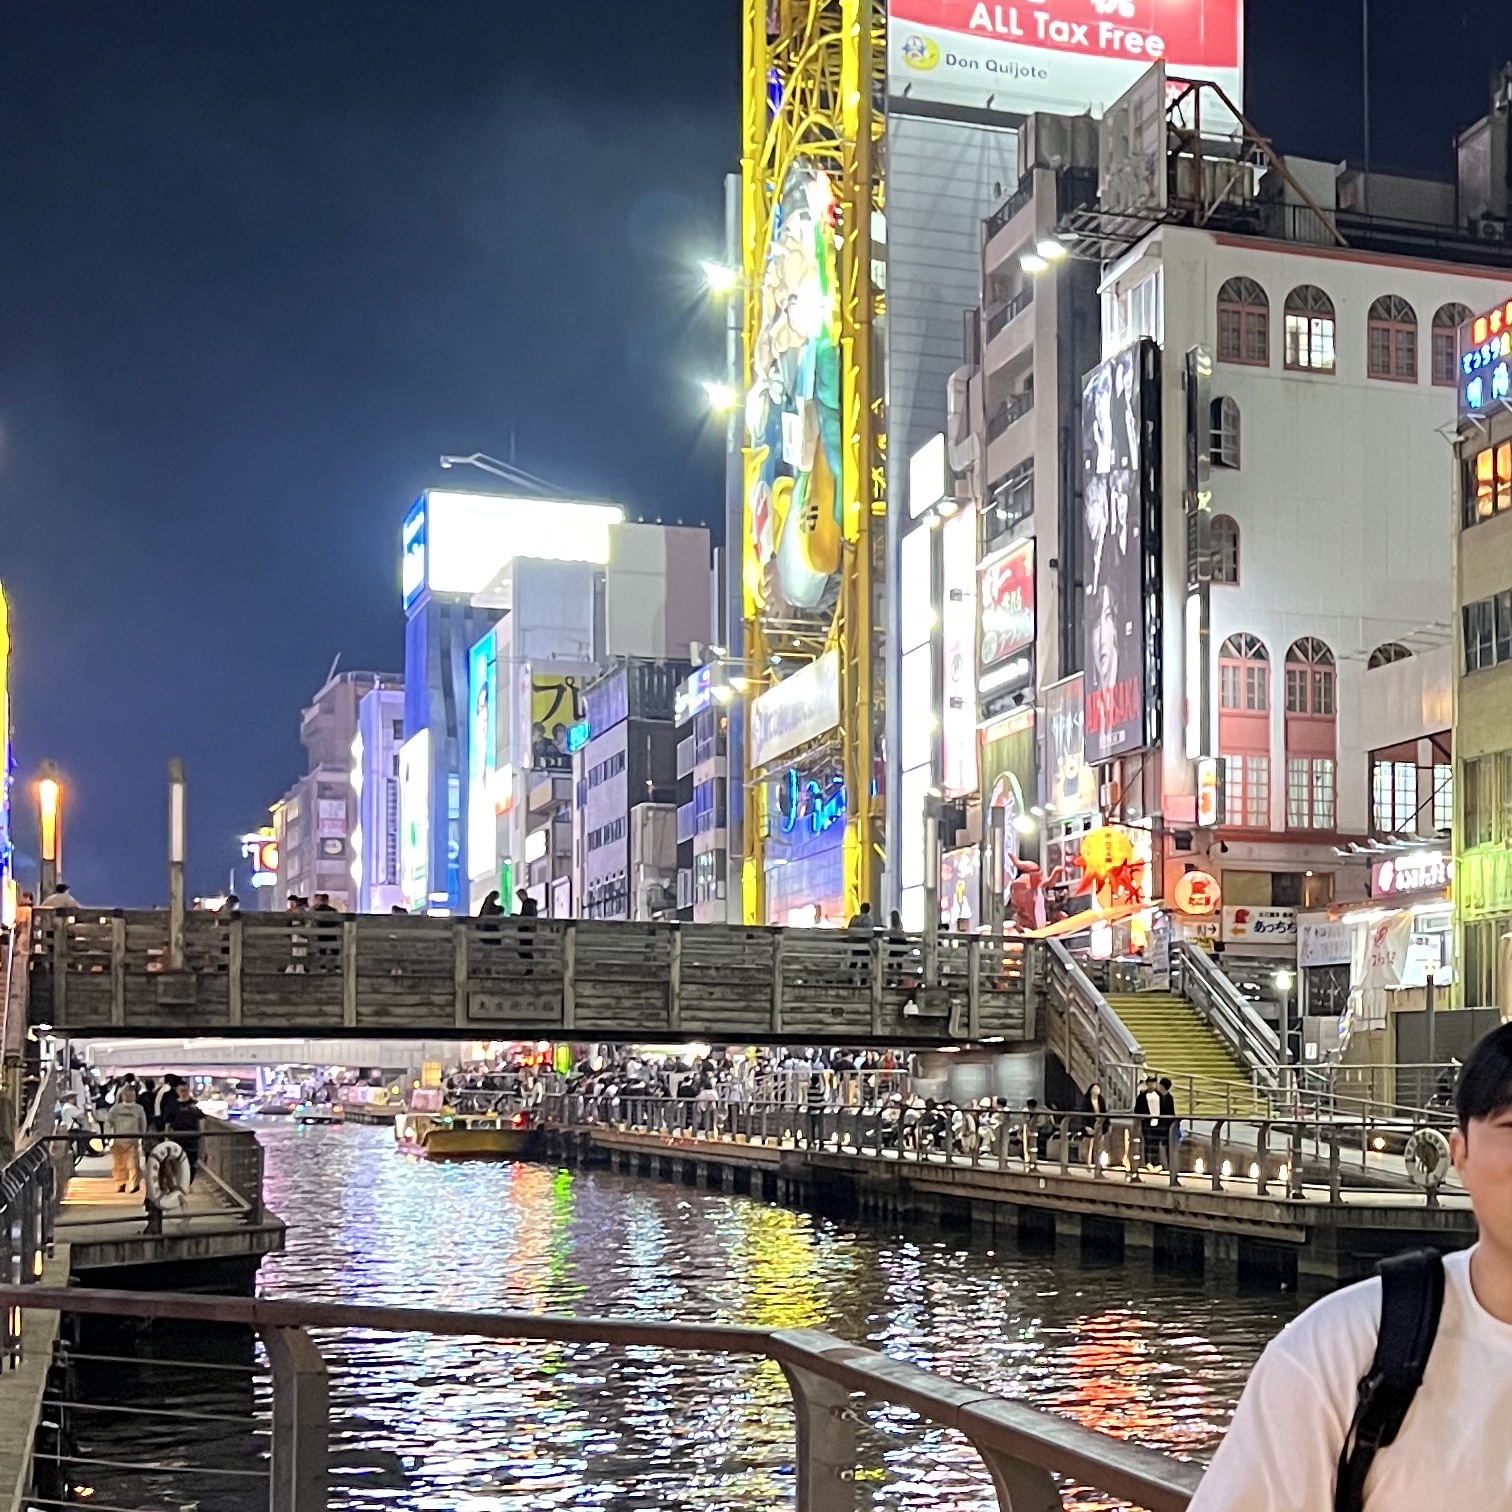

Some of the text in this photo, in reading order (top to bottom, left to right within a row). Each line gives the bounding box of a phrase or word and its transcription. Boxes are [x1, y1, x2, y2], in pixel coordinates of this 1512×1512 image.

[970, 4, 1165, 57] ALL Tax Free
[946, 53, 1048, 80] Don Quijote
